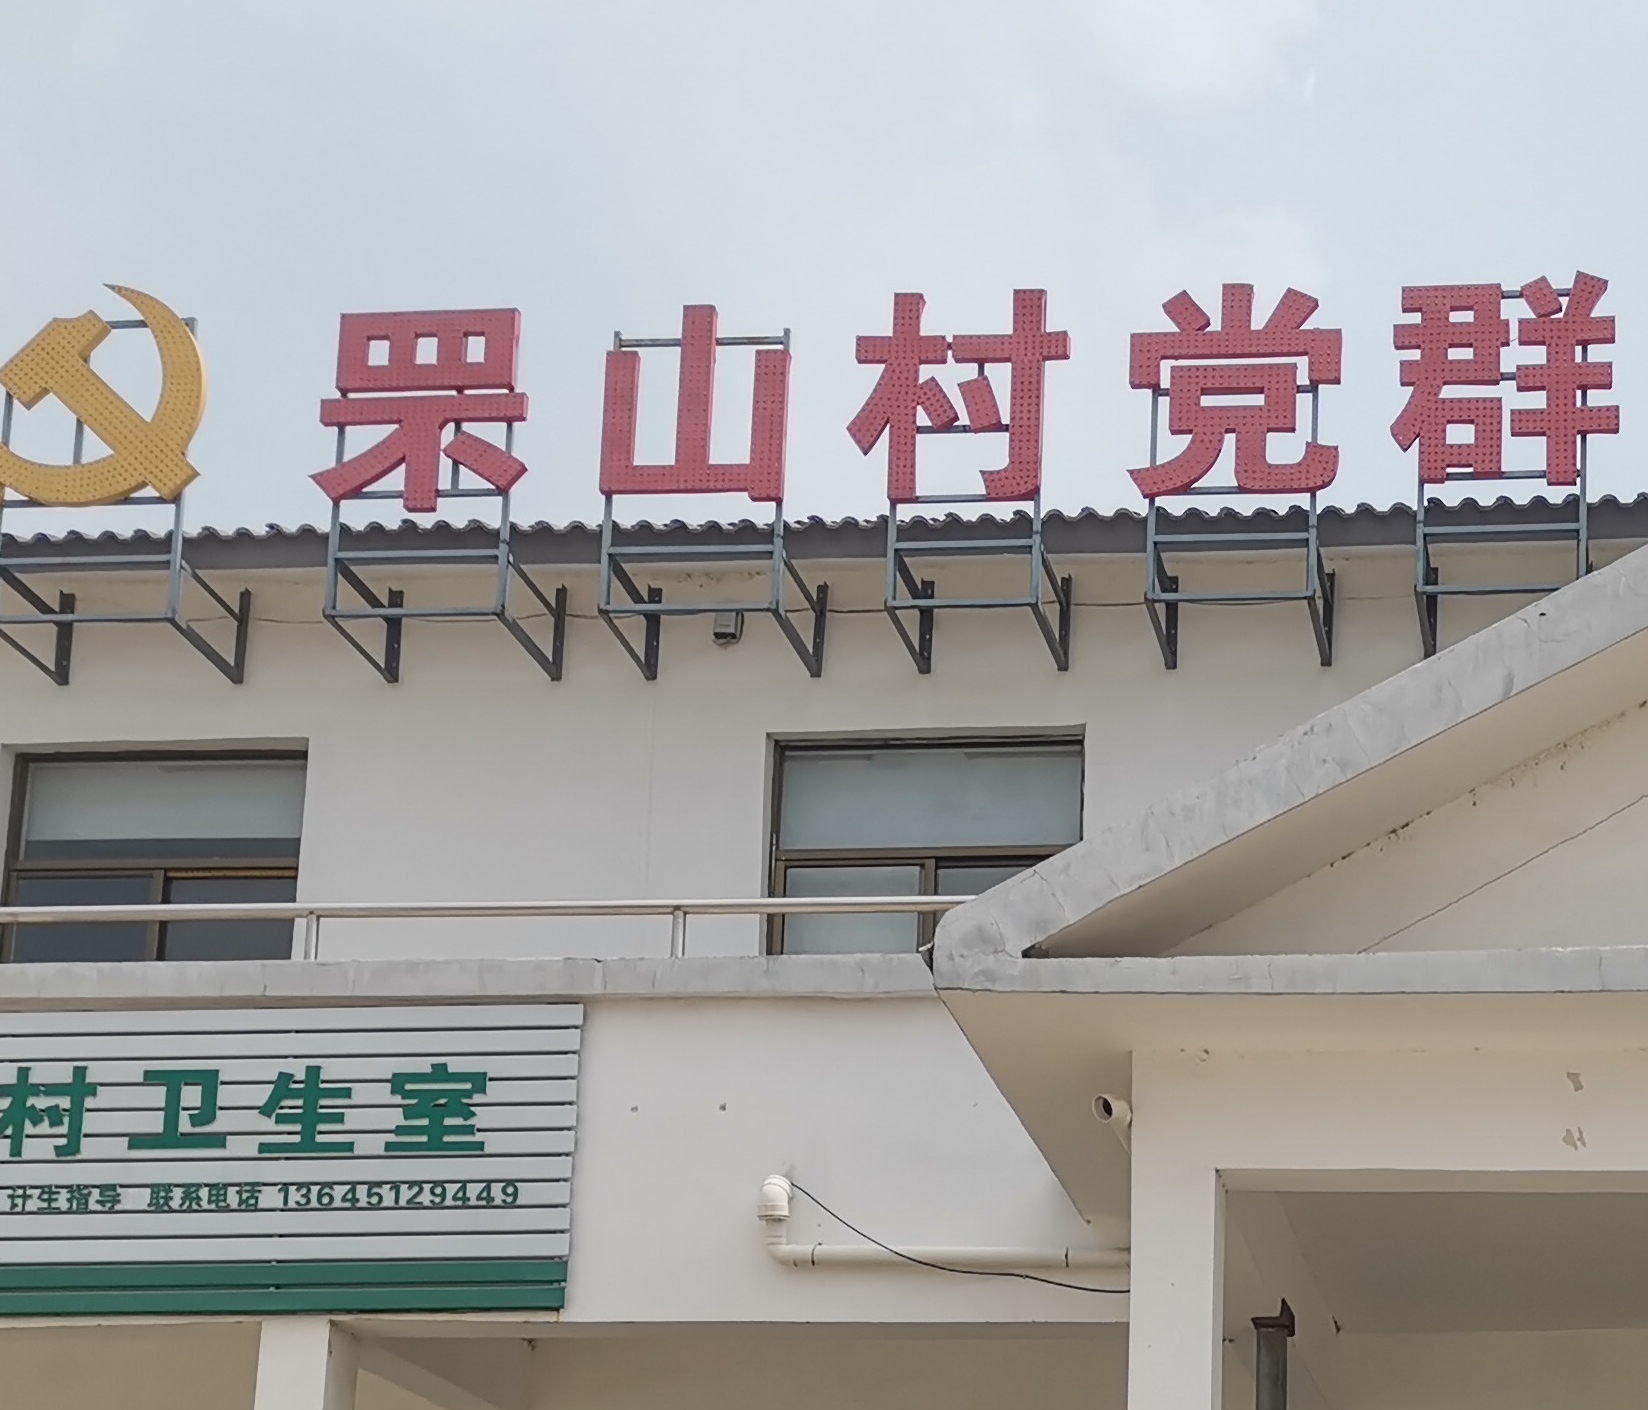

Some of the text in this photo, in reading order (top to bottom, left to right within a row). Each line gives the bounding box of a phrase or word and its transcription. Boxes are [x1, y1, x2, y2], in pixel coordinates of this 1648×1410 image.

[0, 1062, 488, 1158] 村卫生室
[146, 1182, 263, 1211] 联系电话
[277, 1180, 520, 1209] 13645129449
